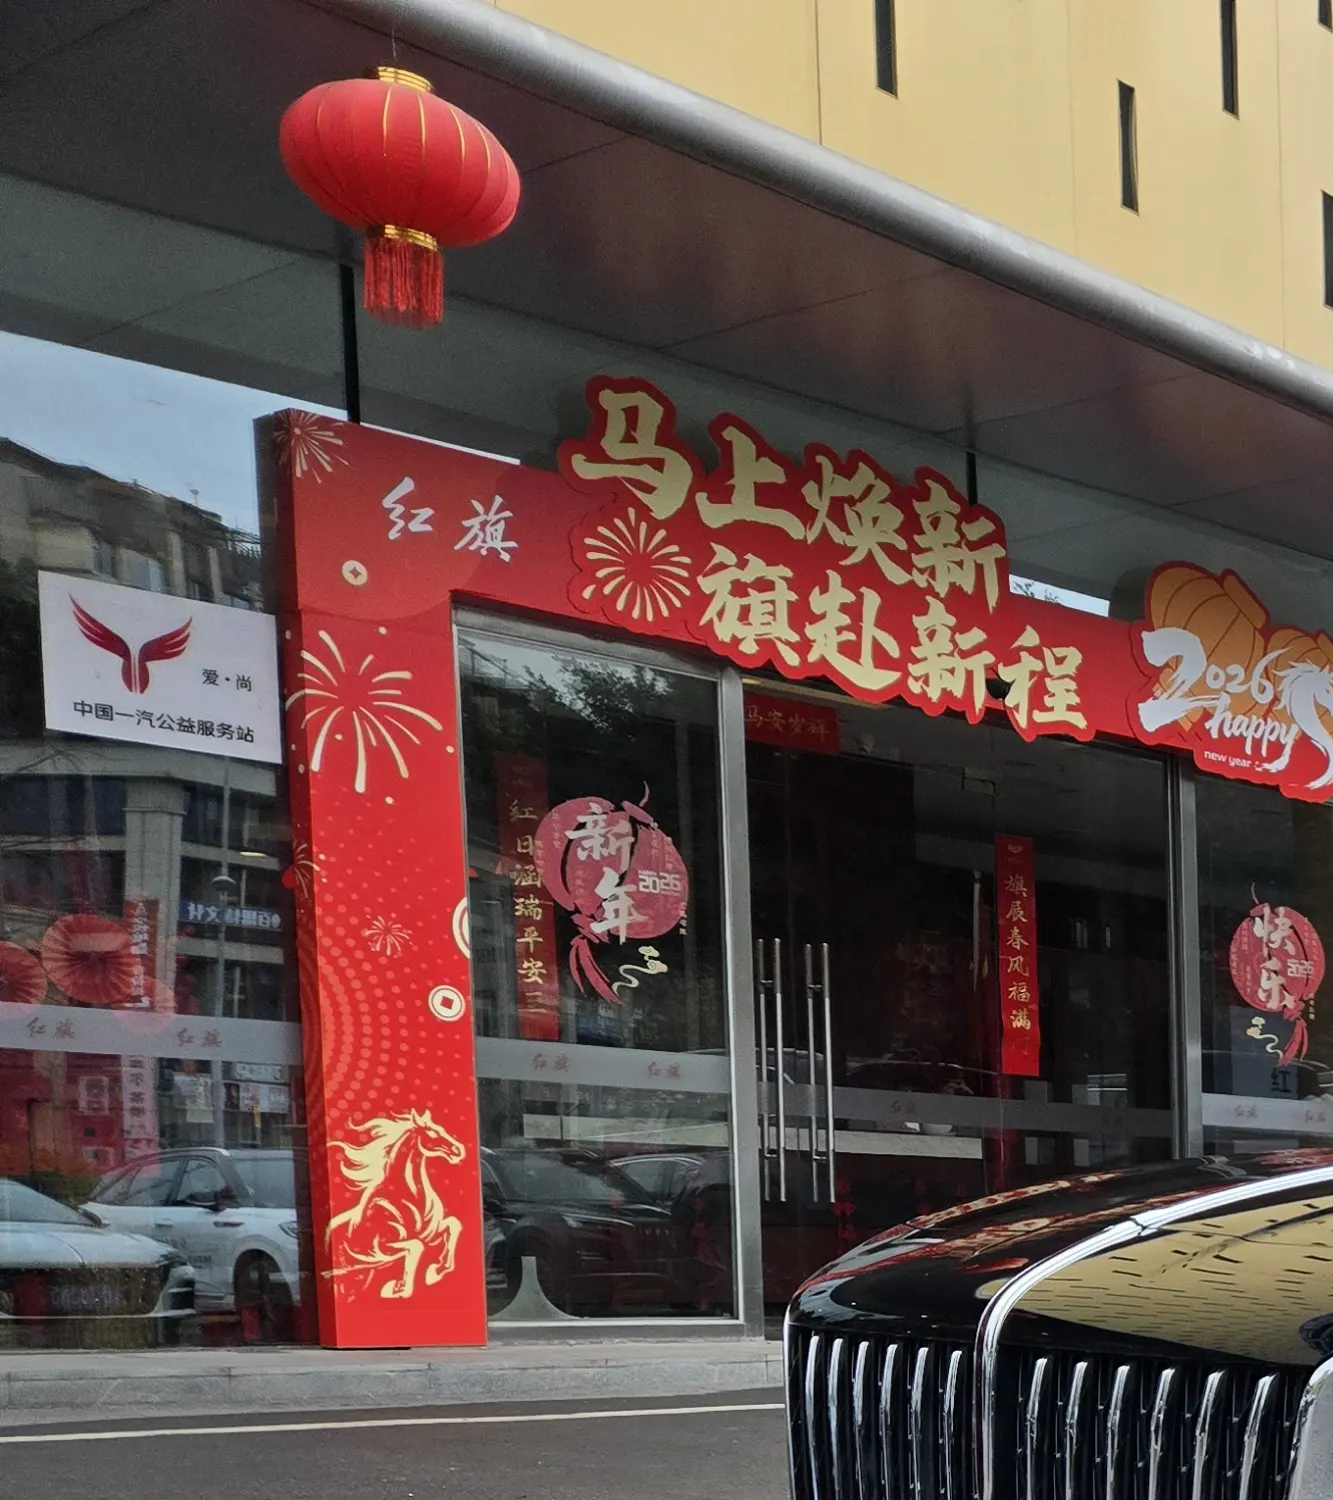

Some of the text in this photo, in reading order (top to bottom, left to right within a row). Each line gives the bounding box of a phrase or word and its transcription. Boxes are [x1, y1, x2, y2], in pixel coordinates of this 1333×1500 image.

[381, 477, 519, 563] 红旗
[573, 388, 1005, 614] 马上焕新
[699, 543, 1087, 730] 旗赴新程
[1137, 627, 1294, 732] 2026
[73, 700, 254, 743] 中国一汽公益服务站
[1204, 691, 1300, 773] happy
[1204, 750, 1252, 768] new year
[565, 802, 649, 945] 新年
[1253, 903, 1296, 1009] 快乐
